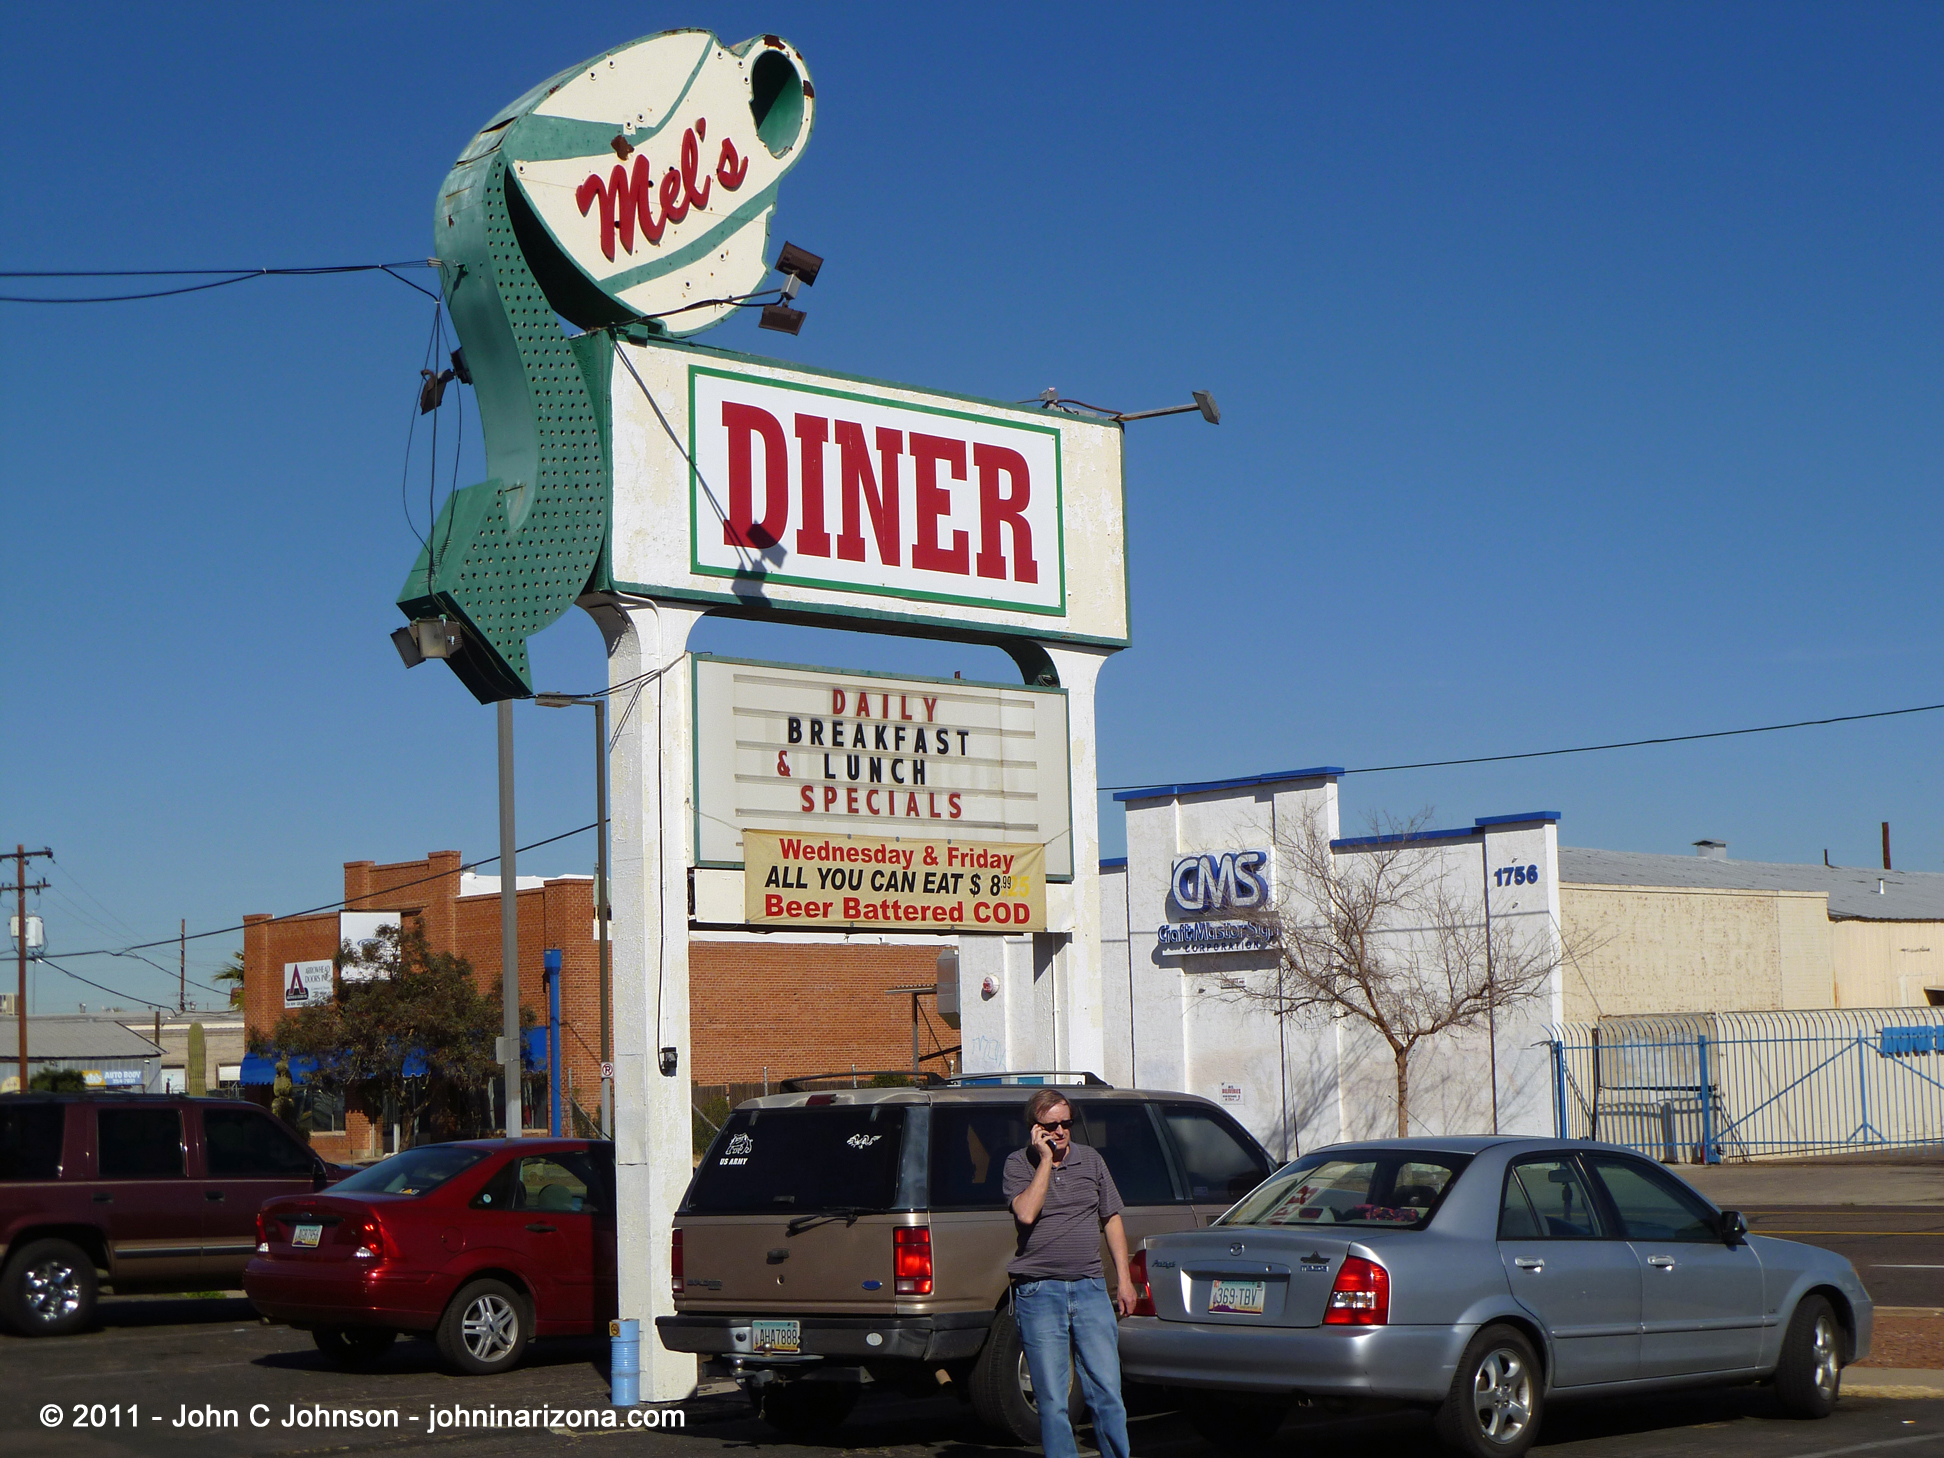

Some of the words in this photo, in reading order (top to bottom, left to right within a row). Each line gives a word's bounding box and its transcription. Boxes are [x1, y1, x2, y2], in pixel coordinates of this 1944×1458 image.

[575, 117, 749, 263] Mel's
[721, 400, 1039, 585] DINER
[832, 688, 938, 722] DAILY
[787, 717, 970, 756] BREAKFAST
[776, 750, 791, 777] &
[824, 753, 926, 785] LUNCH
[800, 785, 962, 819] SPECIALS
[778, 838, 914, 870] Wednesday
[922, 845, 939, 866] &
[947, 846, 1015, 875] Friday
[765, 865, 808, 889] ALL
[817, 867, 864, 892] YOU
[869, 869, 917, 894] CAN
[922, 871, 964, 895] EAT
[968, 872, 982, 898] $
[1170, 850, 1269, 912] CMS
[1493, 863, 1539, 888] 1756
[765, 894, 834, 919] Beer
[842, 897, 964, 923] Battered
[973, 901, 1031, 924] COD
[1185, 941, 1260, 952] CORPORATION
[104, 1071, 123, 1079] AUTO
[123, 1071, 142, 1079] BODY
[719, 1158, 728, 1166] US
[728, 1157, 748, 1165] ARMY
[759, 1329, 798, 1345] AHA7888
